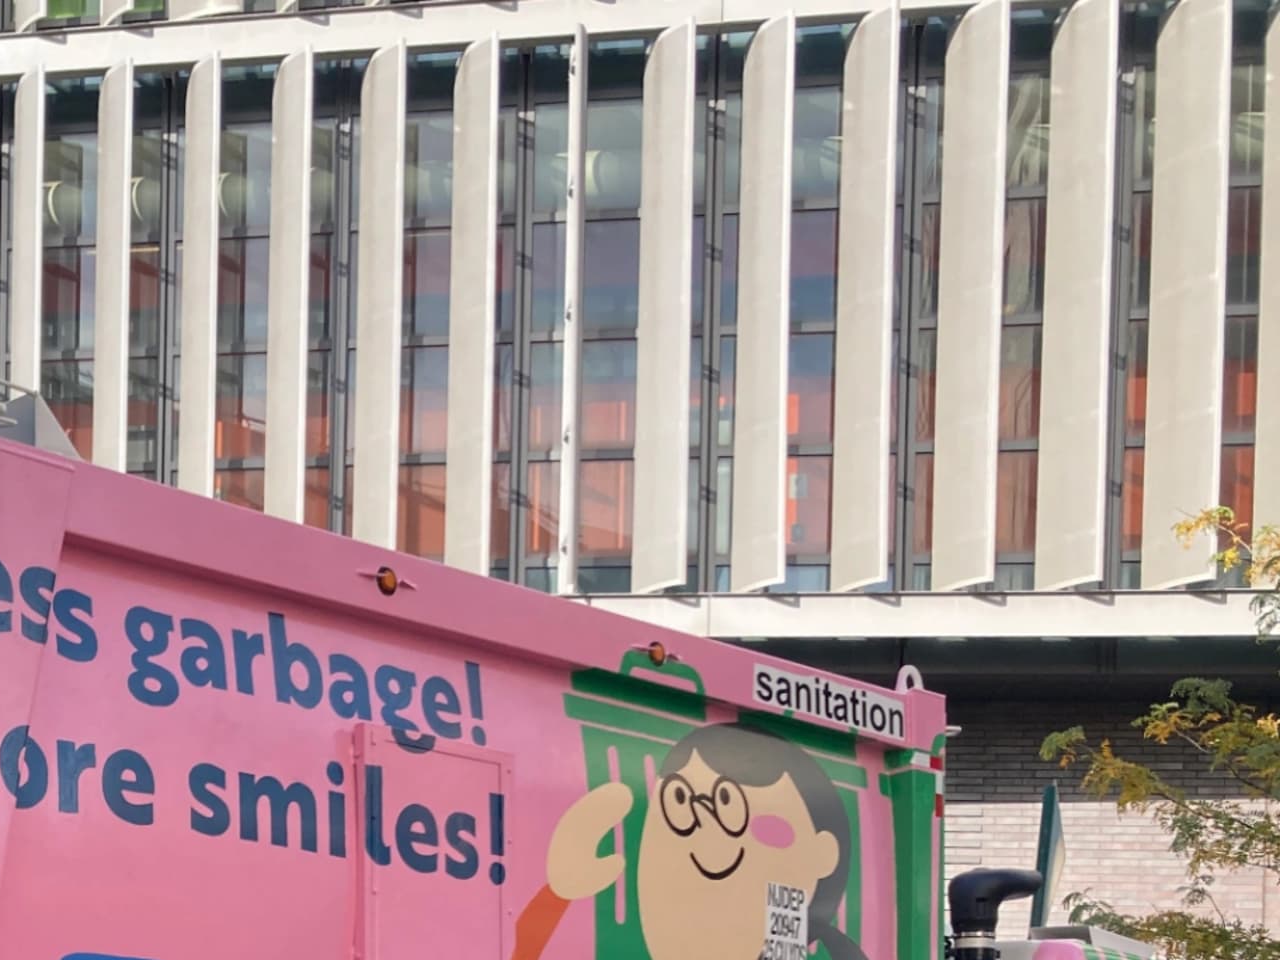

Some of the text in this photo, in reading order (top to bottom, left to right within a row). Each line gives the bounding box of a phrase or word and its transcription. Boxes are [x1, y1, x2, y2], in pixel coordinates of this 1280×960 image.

[125, 611, 487, 754] garbage!
[756, 672, 904, 738] sanitation
[188, 761, 507, 886] smiles!
[767, 882, 805, 912] NJDEP
[770, 911, 801, 939] 20947
